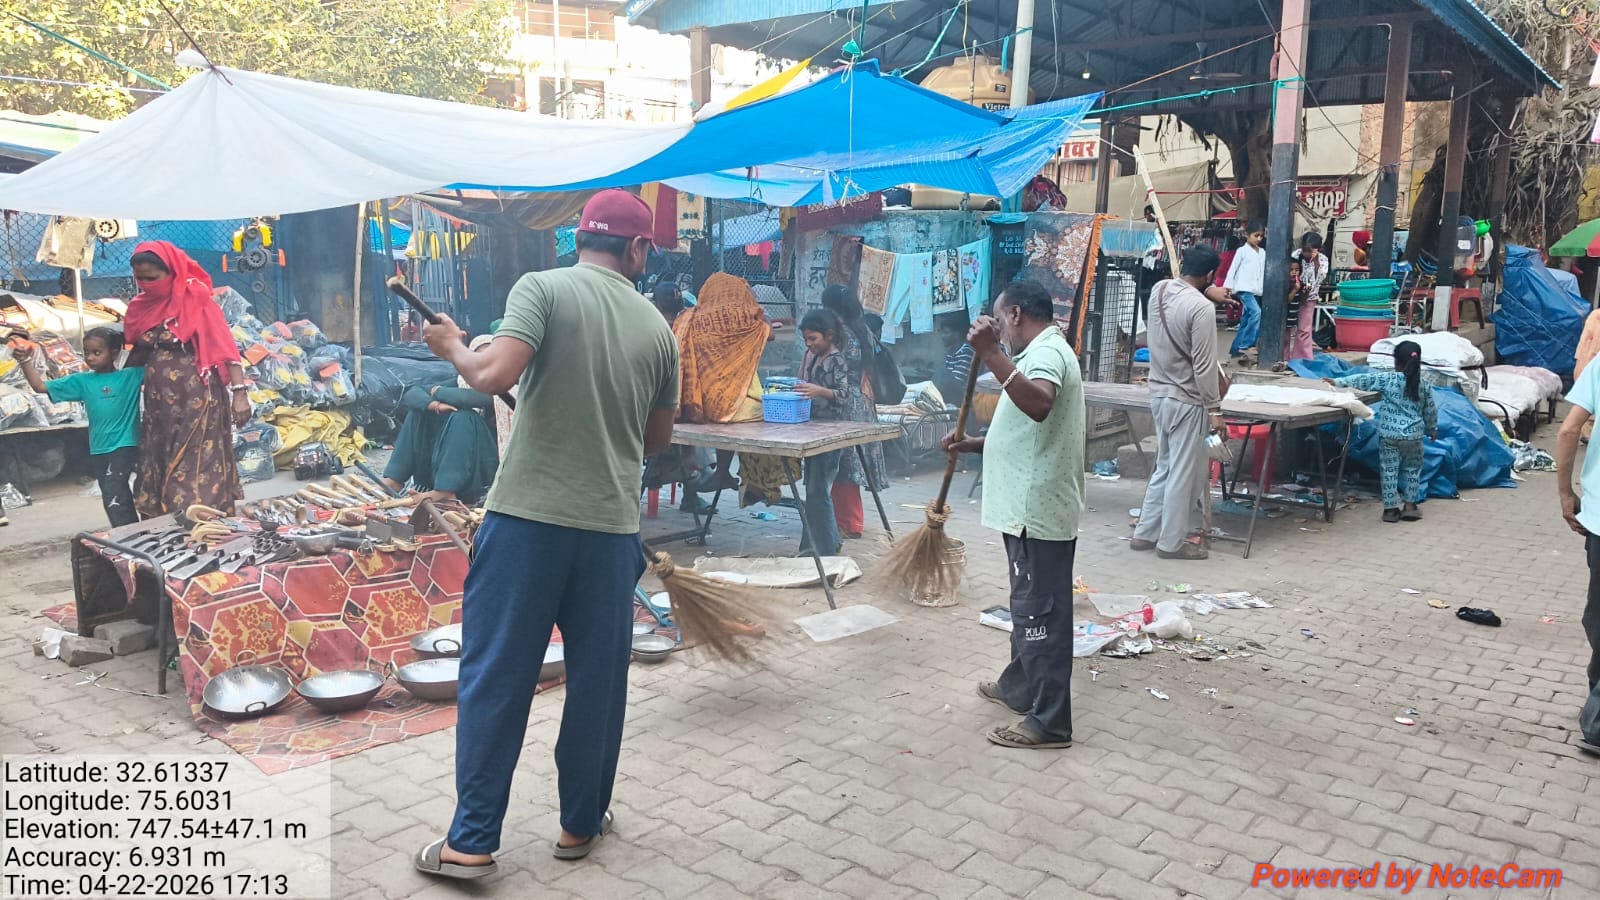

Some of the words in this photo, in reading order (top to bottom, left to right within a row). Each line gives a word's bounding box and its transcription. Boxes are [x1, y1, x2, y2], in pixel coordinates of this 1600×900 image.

[1063, 140, 1097, 158] ावर
[1304, 190, 1345, 210] SHOP
[1025, 625, 1047, 637] POLO
